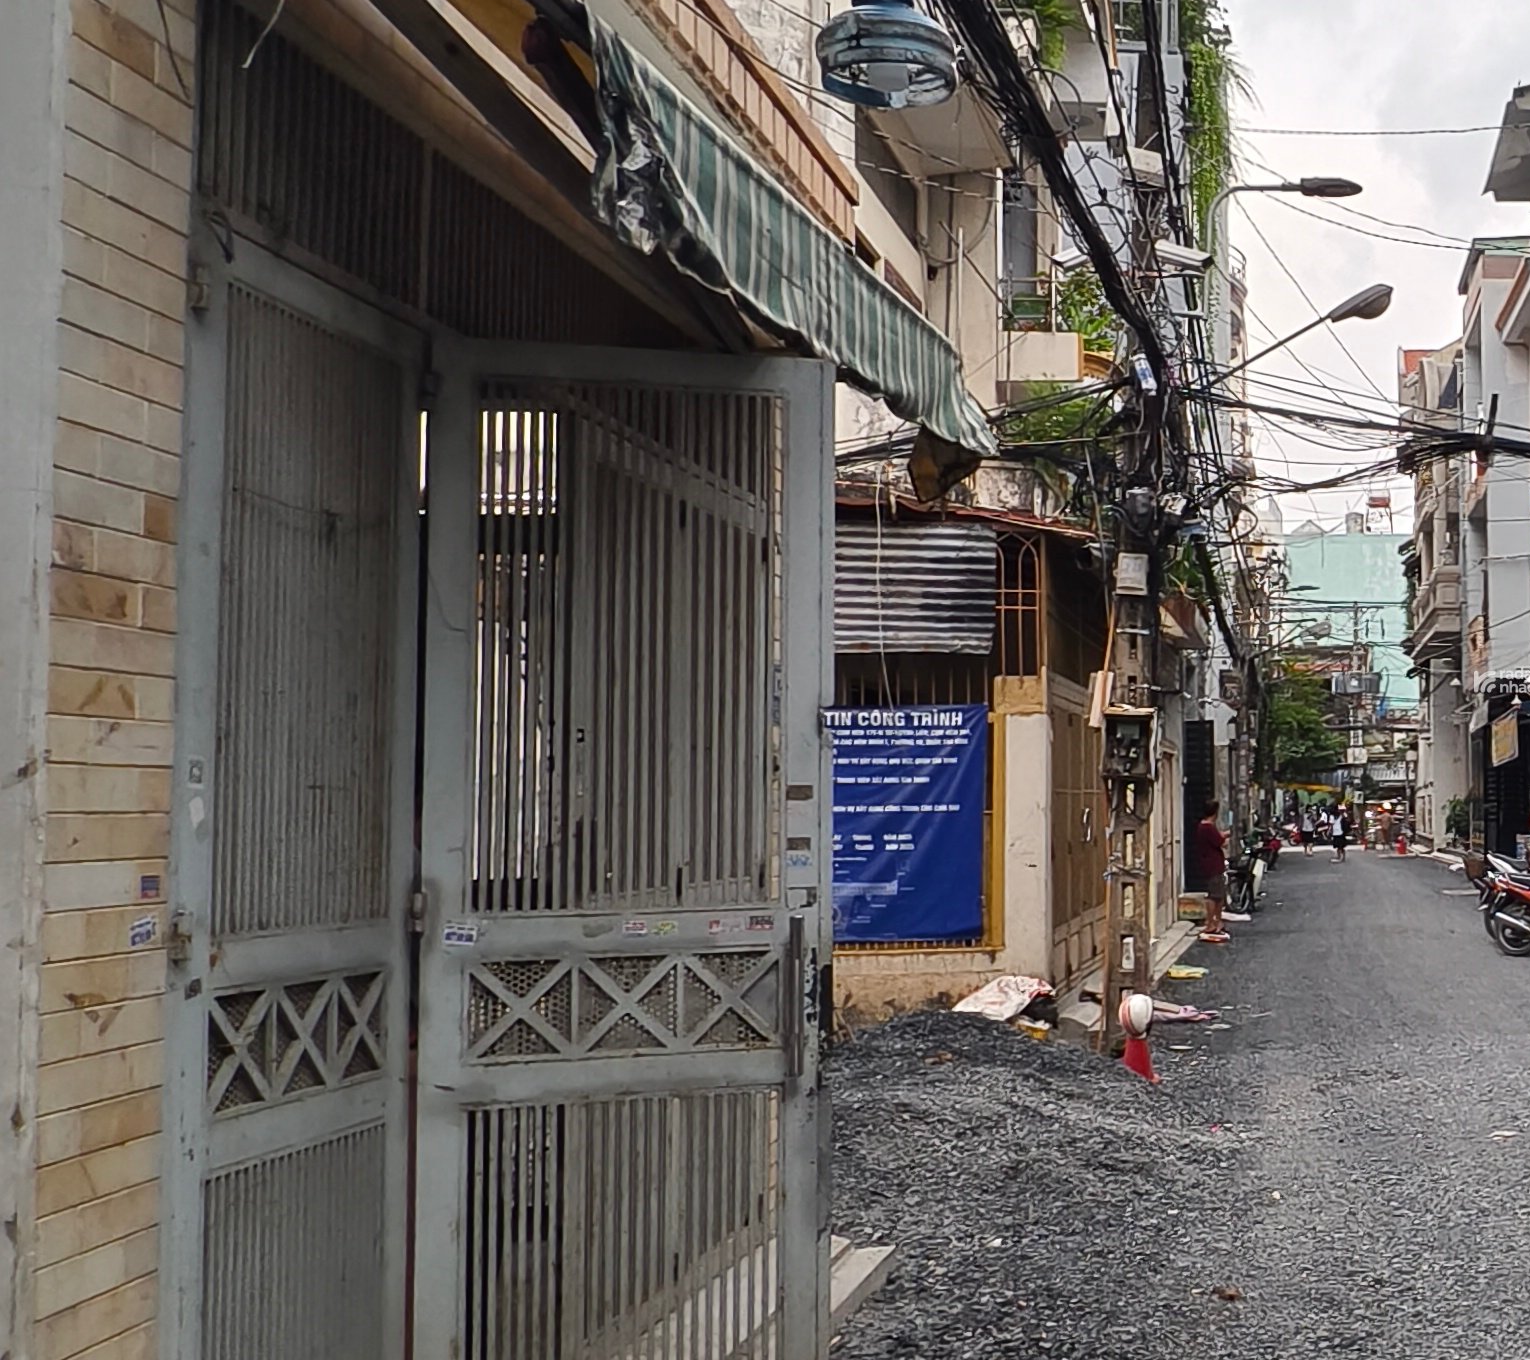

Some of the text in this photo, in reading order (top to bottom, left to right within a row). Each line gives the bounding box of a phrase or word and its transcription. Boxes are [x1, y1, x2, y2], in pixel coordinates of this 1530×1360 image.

[824, 709, 963, 726] TIN CÔNG TRÌNH
